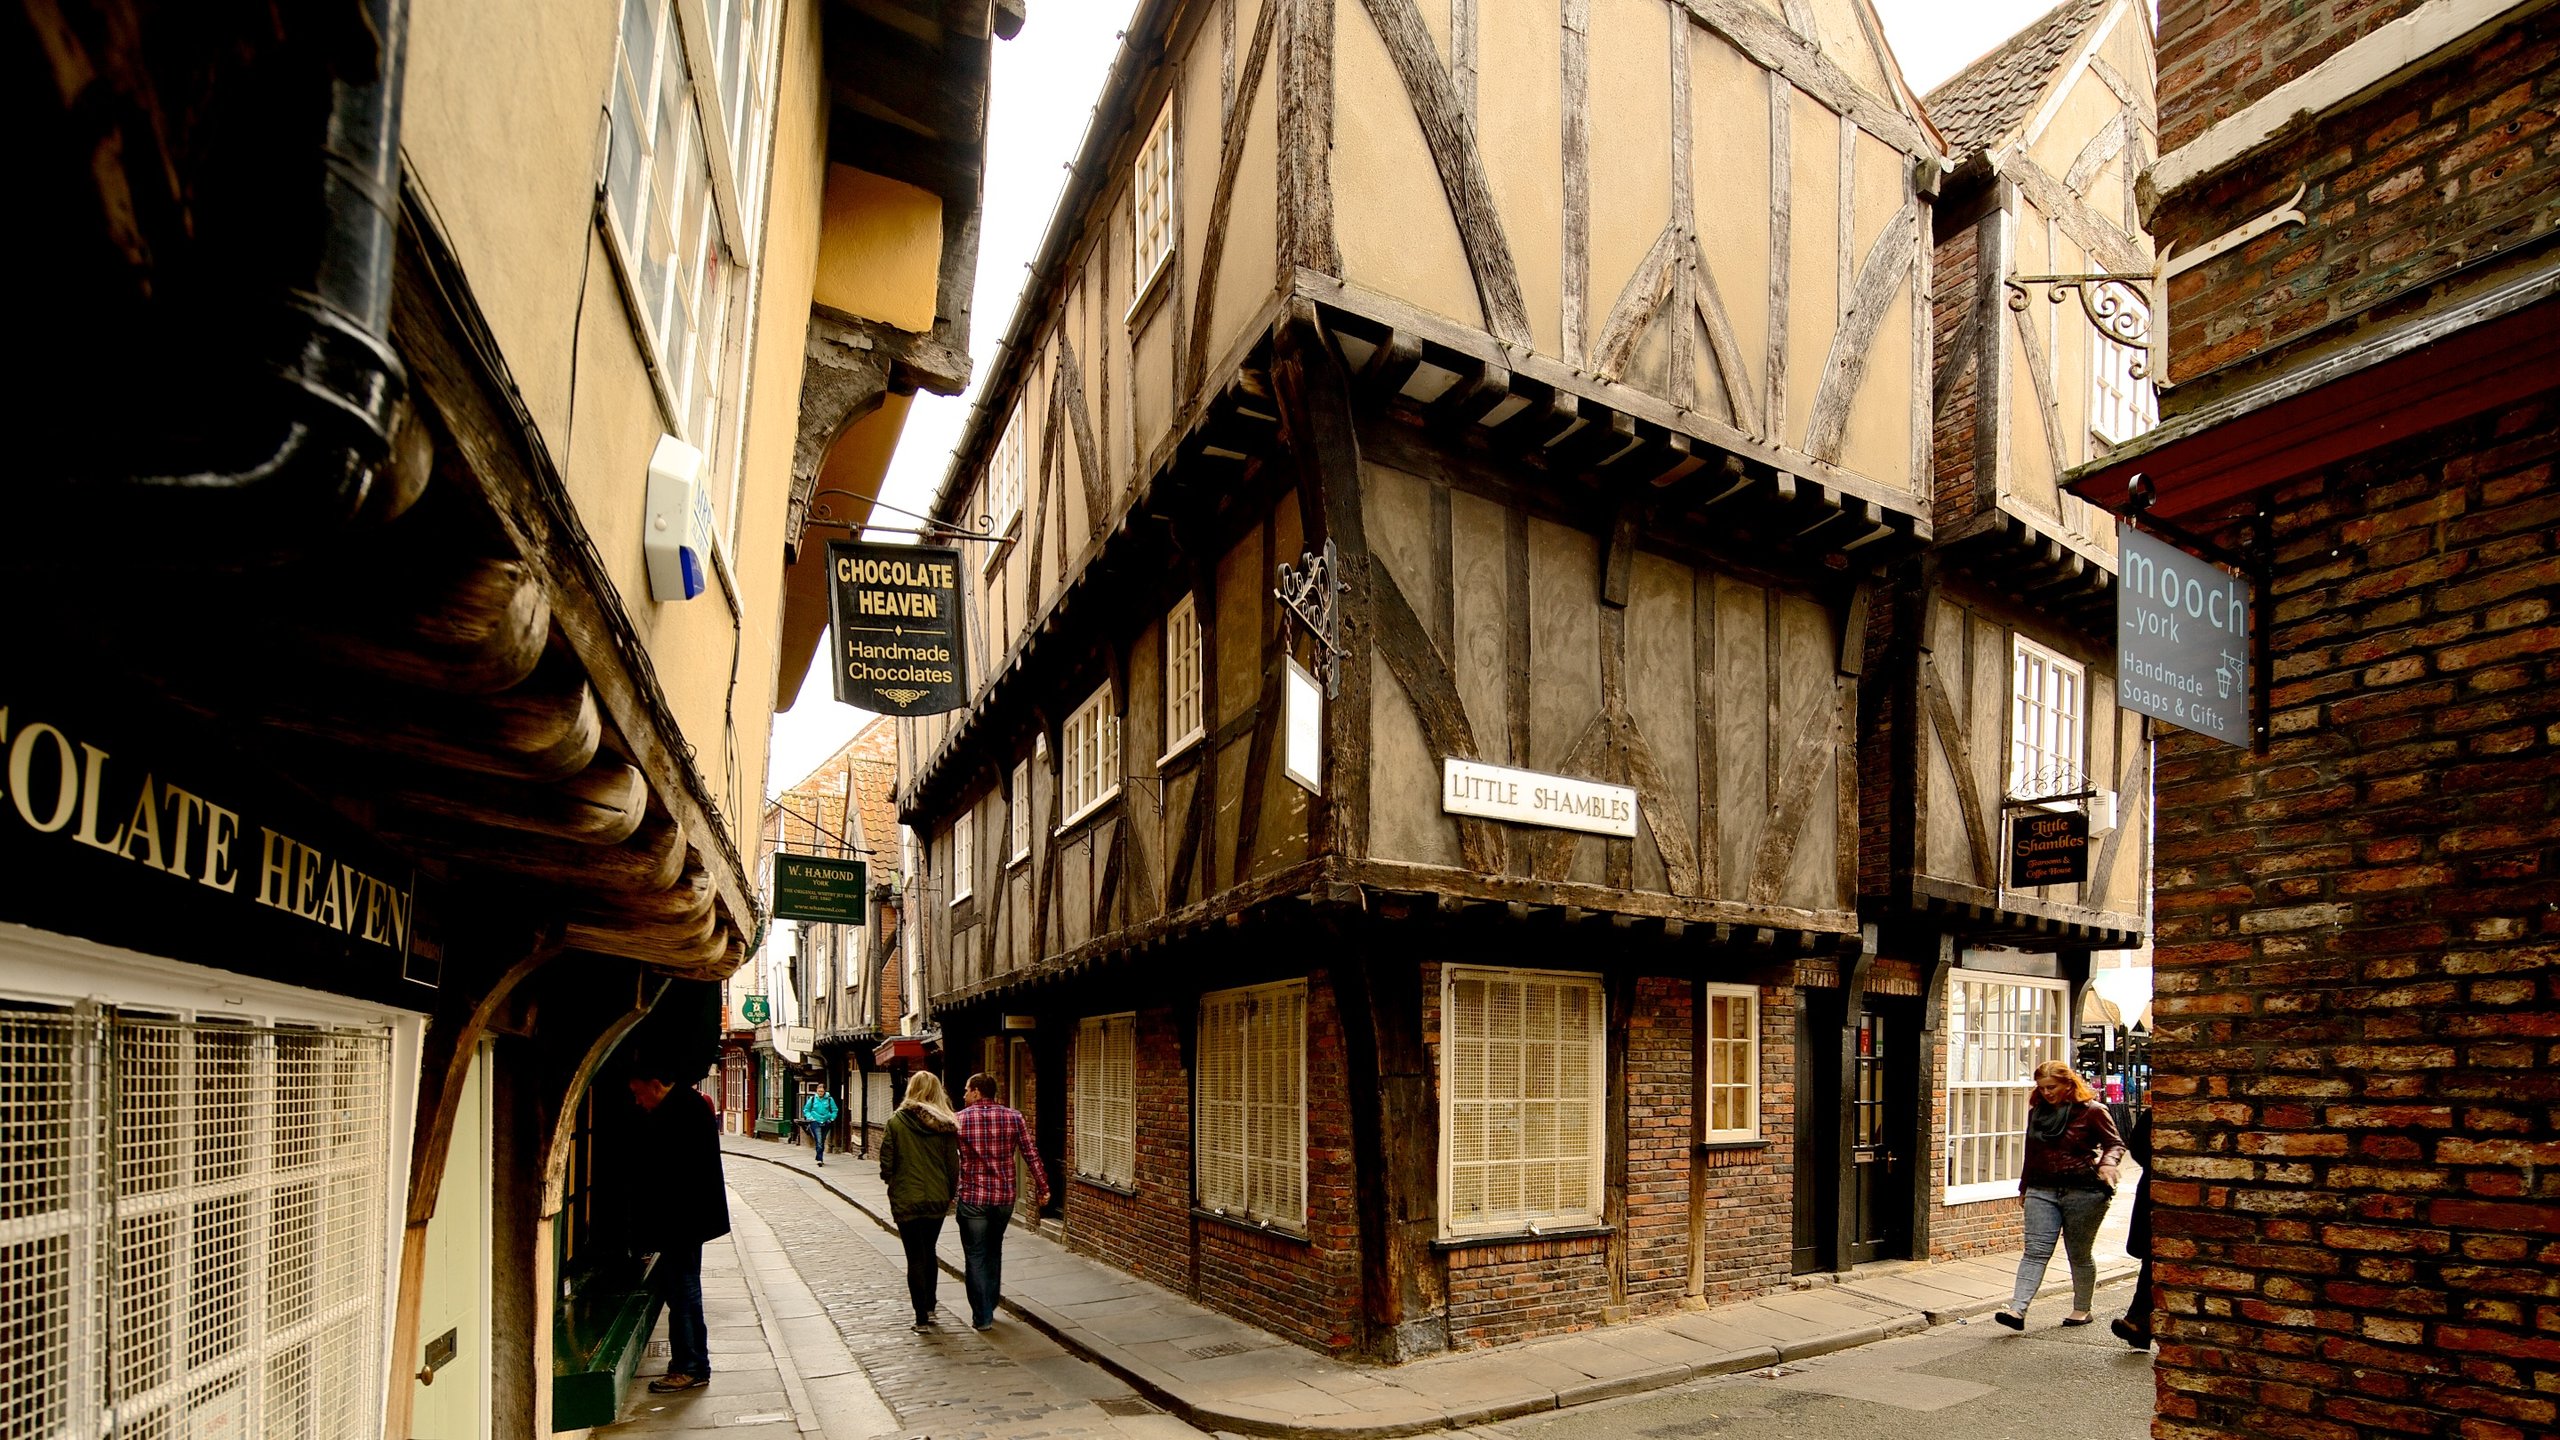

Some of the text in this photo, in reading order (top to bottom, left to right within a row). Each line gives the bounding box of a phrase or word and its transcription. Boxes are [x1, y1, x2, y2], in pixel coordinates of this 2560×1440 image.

[837, 558, 954, 589] CHOCOLATE
[859, 590, 937, 618] HEAVEN
[2125, 548, 2244, 638] mooch
[848, 640, 950, 662] Handmade
[848, 662, 953, 684] Chocolates
[2124, 650, 2203, 697] Handmade
[2124, 679, 2224, 731] Soaps & Gifts
[1533, 787, 1630, 822] SHAMBLES
[0, 705, 410, 952] OLATE HEAVEN
[2031, 819, 2068, 838] Little
[2016, 835, 2084, 857] Shambles
[788, 865, 854, 881] W. HAMOND
